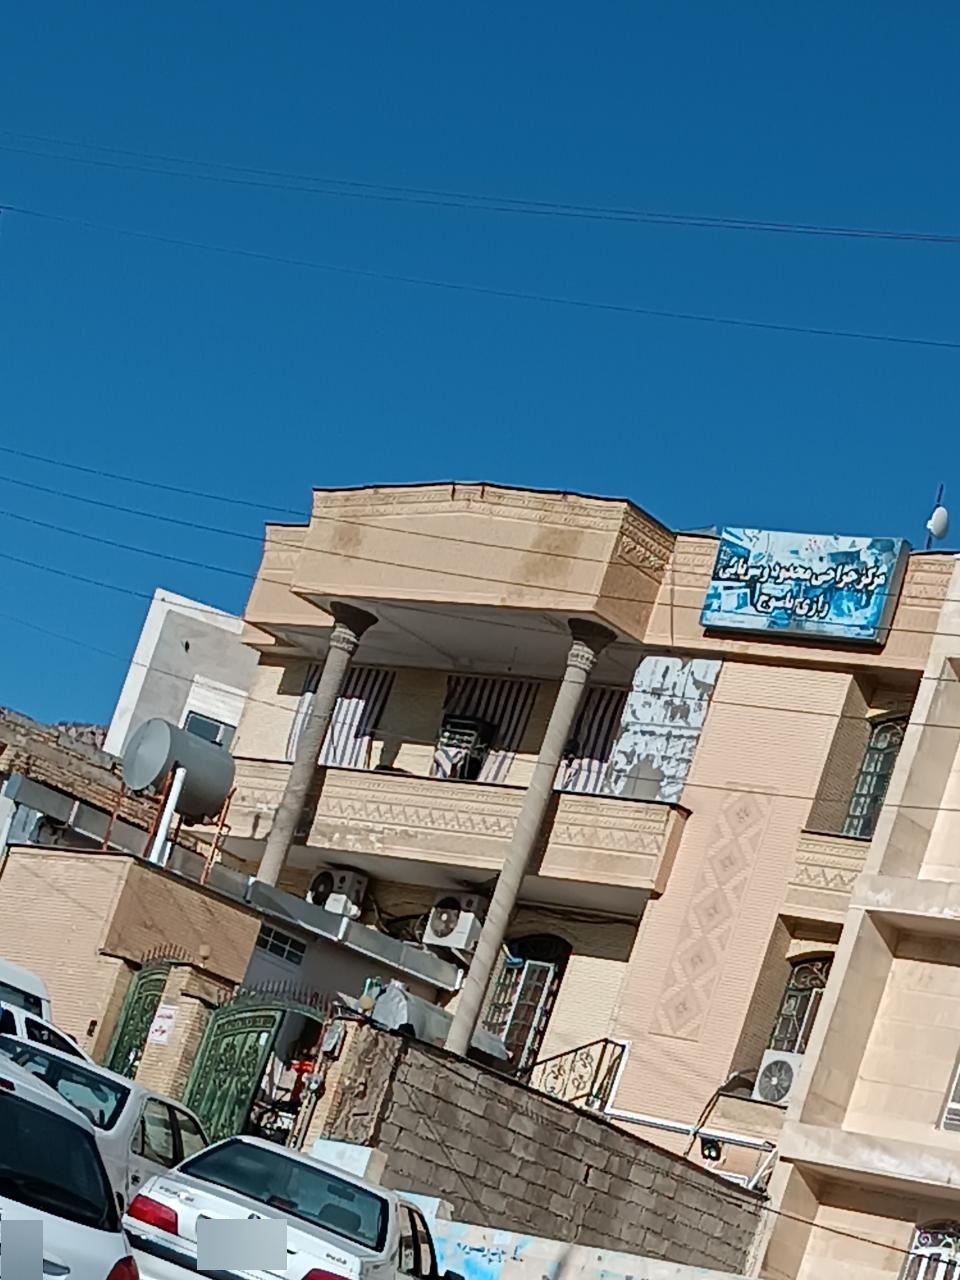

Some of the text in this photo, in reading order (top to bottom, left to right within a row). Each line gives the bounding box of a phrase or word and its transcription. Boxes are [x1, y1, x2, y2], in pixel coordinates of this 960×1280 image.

[811, 564, 857, 588] جراحی
[857, 559, 888, 590] مرکز
[755, 590, 830, 619] رازی یاسوج
